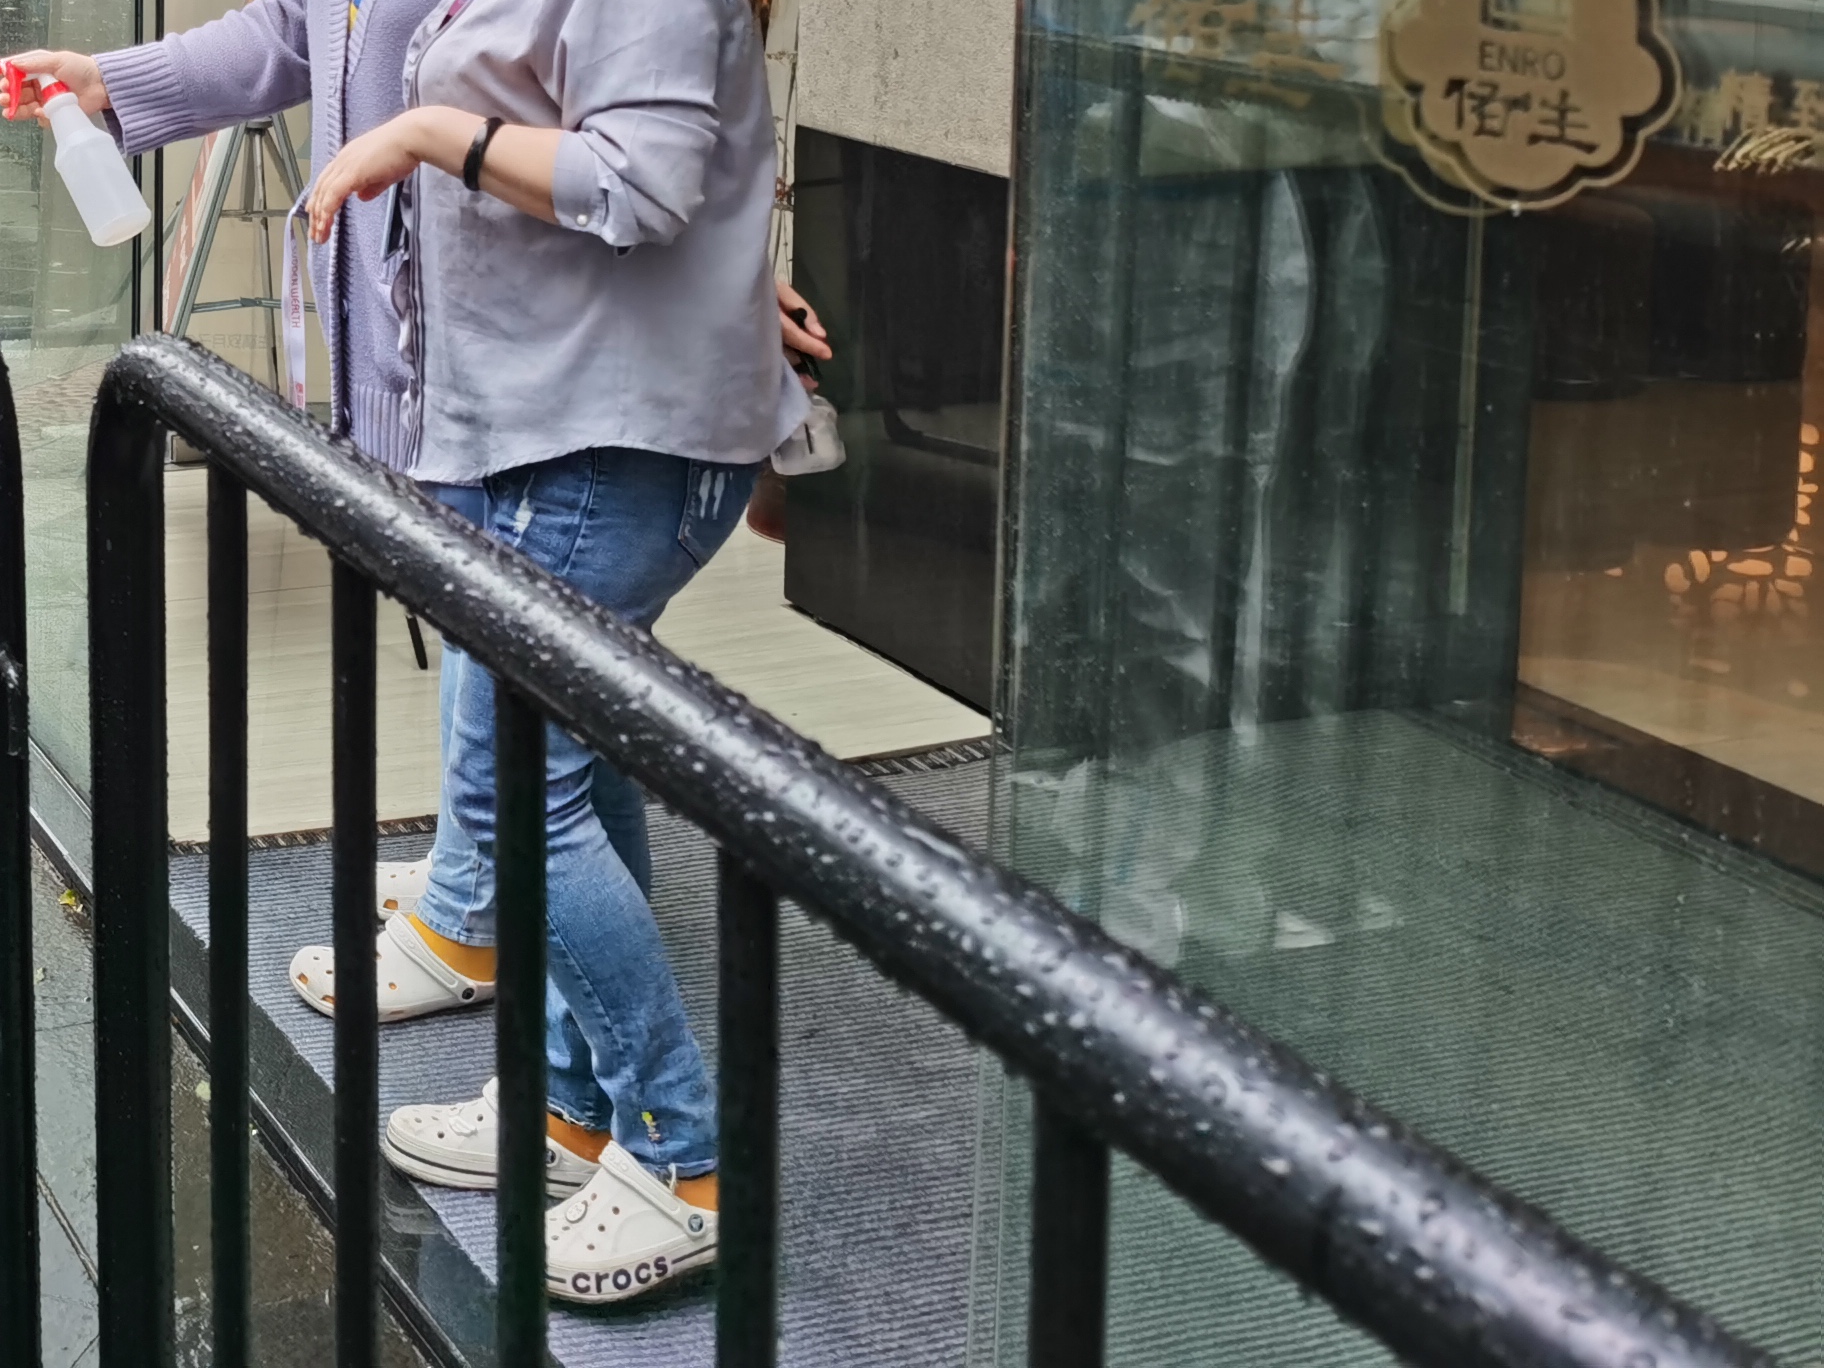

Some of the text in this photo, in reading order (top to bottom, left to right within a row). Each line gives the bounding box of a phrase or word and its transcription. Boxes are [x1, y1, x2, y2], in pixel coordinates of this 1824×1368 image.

[1478, 39, 1567, 81] ENRO
[290, 287, 302, 329] WEALTH
[571, 1255, 669, 1294] crocs
